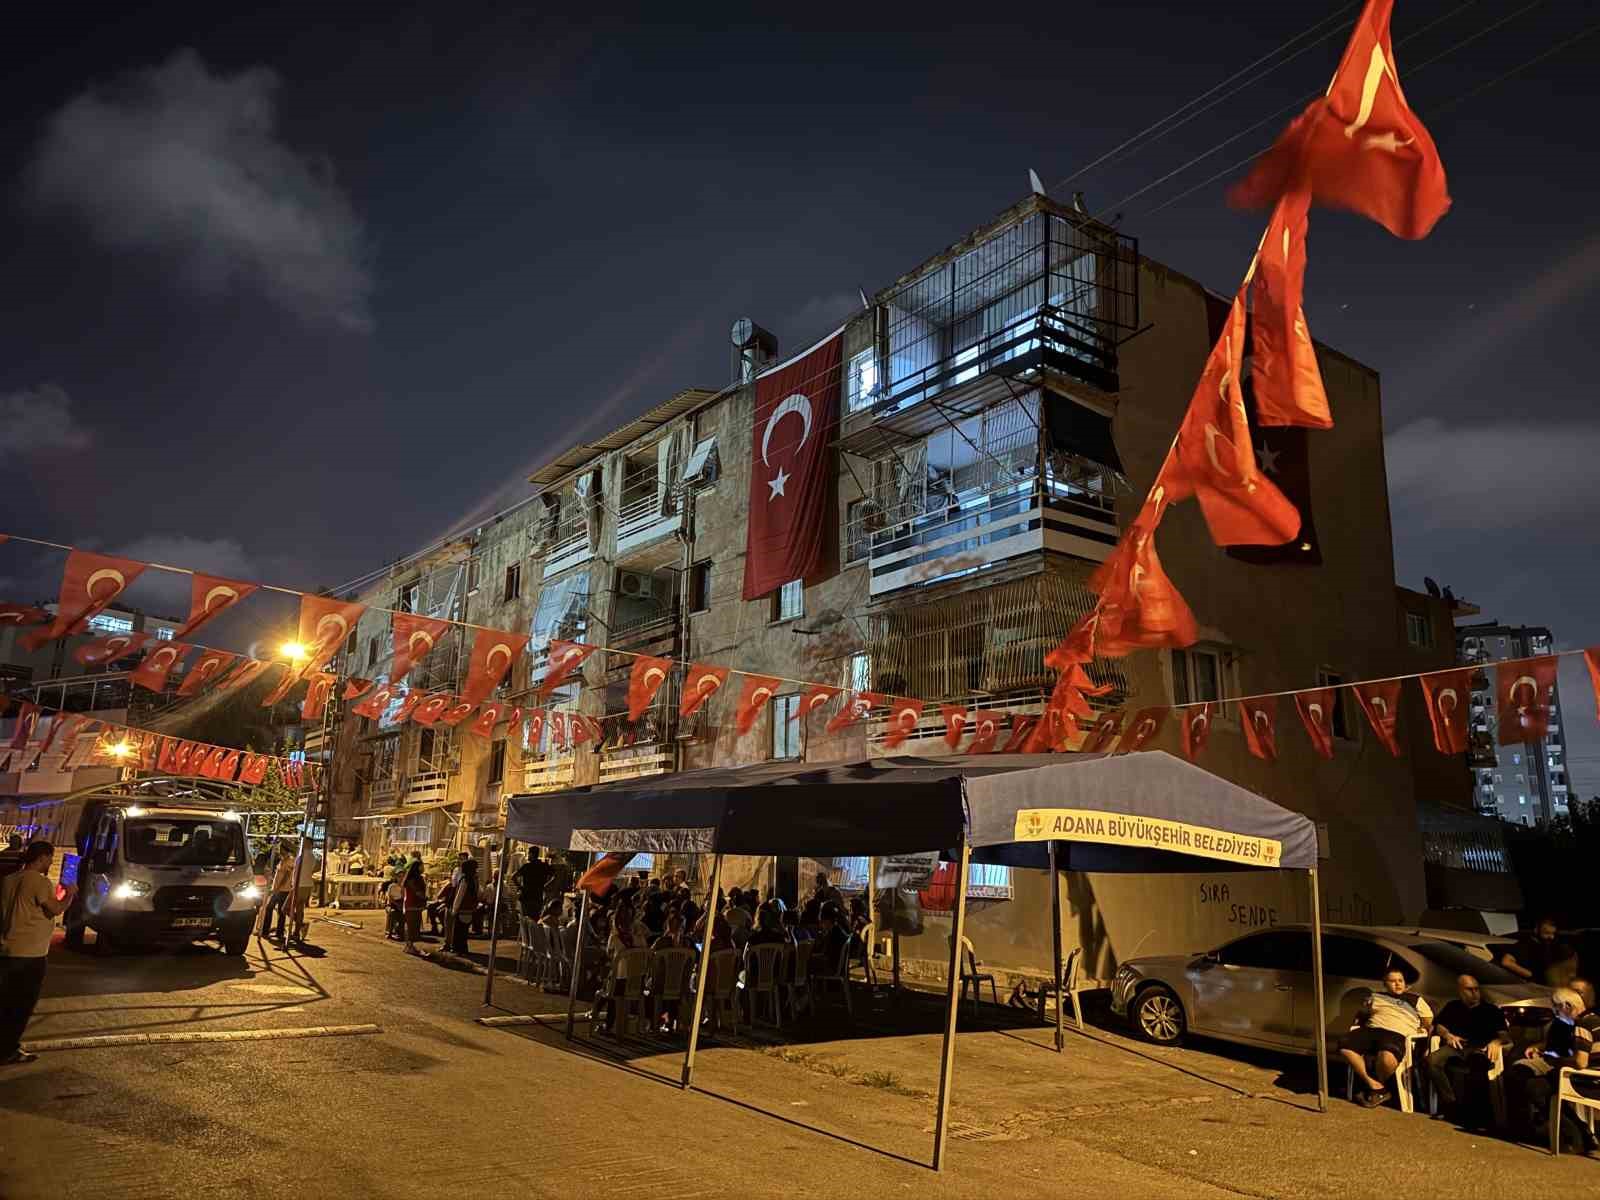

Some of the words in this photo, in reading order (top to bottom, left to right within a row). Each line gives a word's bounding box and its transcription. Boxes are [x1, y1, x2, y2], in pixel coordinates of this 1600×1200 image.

[1053, 815, 1105, 836] ADANA
[1108, 816, 1192, 847] BÜYÜKŞEHİR
[1194, 833, 1262, 859] BELEDİYESİ
[1200, 883, 1230, 904] SIRA
